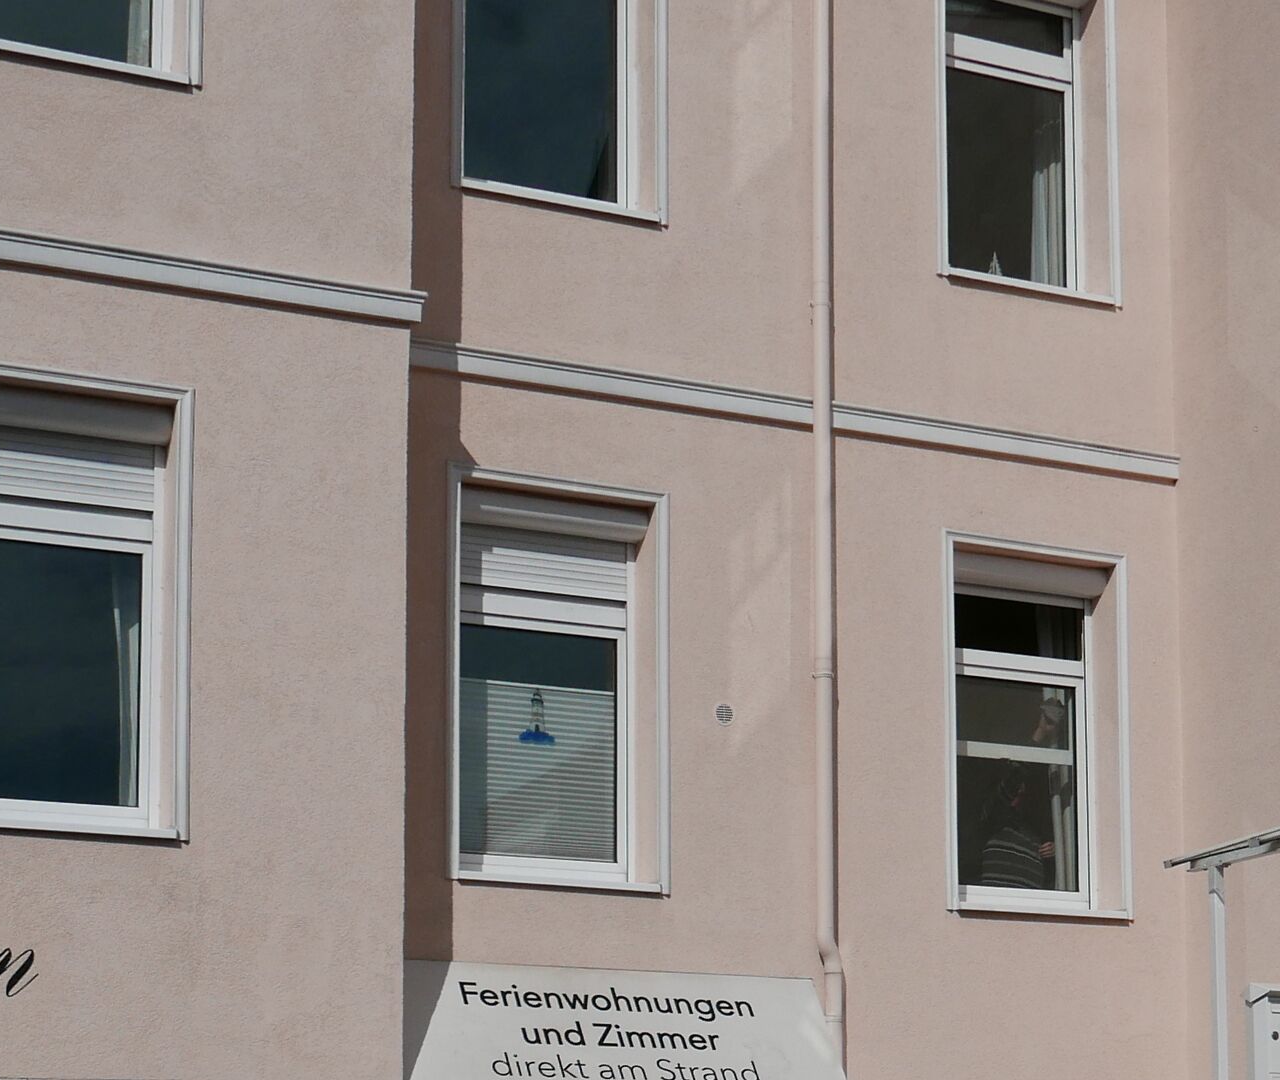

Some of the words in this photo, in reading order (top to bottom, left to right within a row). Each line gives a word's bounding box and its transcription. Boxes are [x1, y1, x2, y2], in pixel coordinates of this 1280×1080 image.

[458, 981, 755, 1022] Ferienwohnungen
[521, 1021, 587, 1046] und
[593, 1022, 720, 1051] Zimmer
[492, 1052, 590, 1080] direkt
[598, 1063, 648, 1080] am
